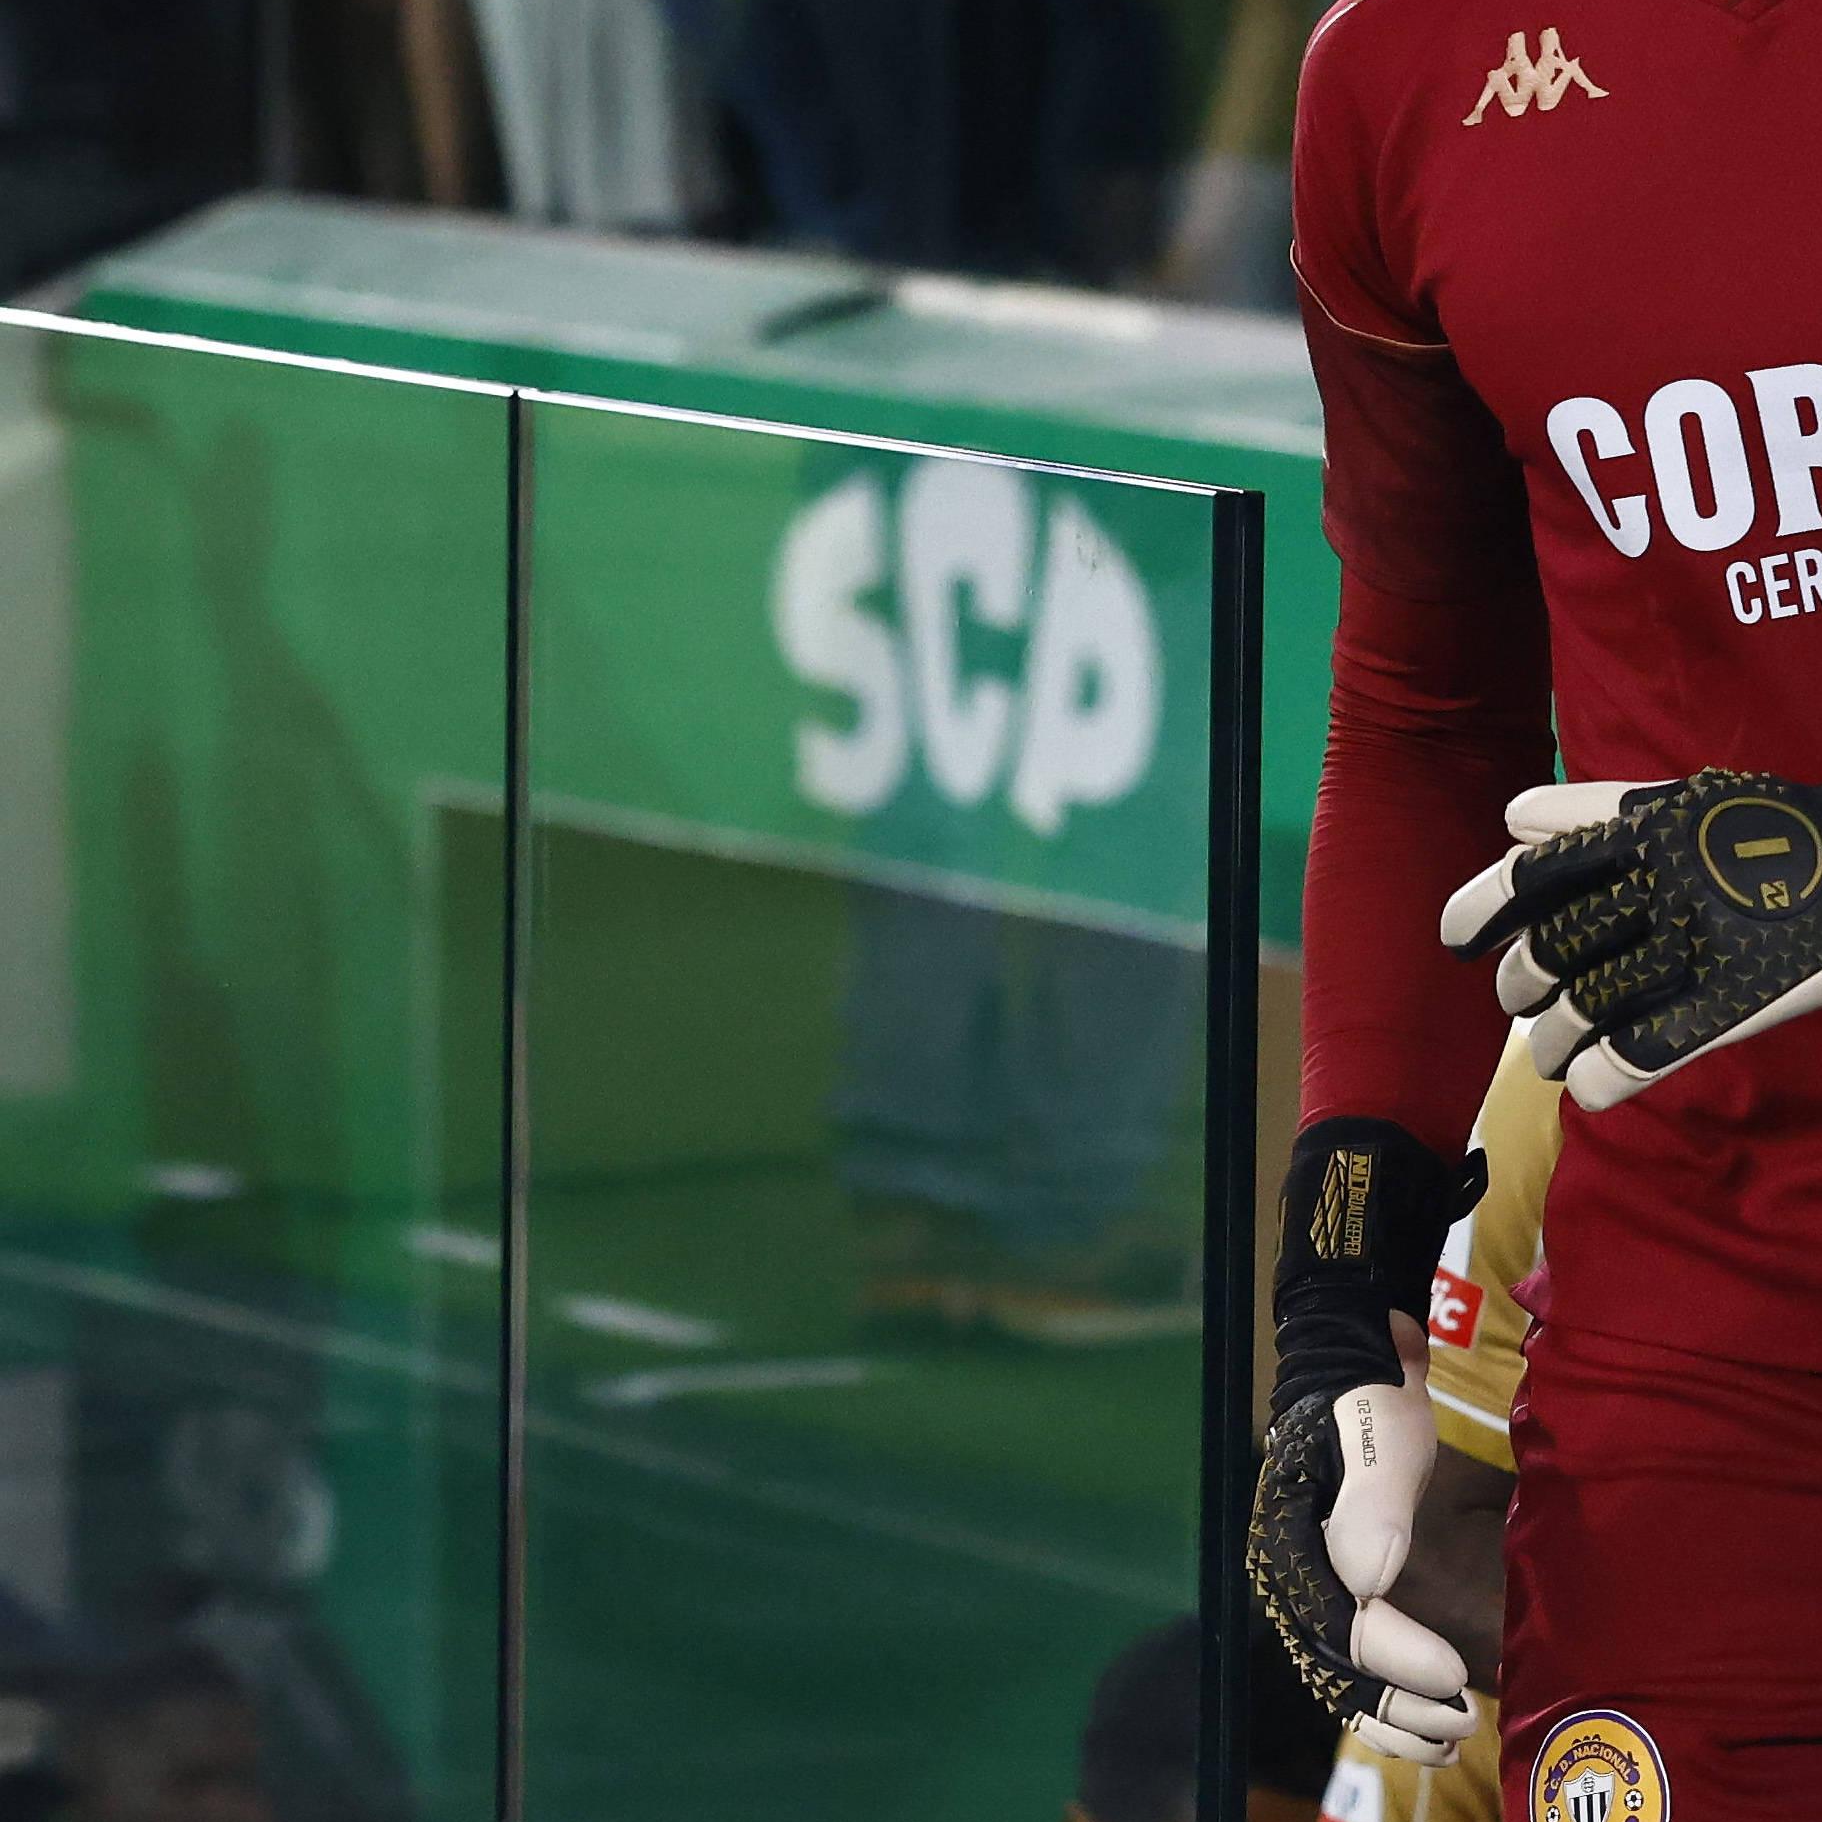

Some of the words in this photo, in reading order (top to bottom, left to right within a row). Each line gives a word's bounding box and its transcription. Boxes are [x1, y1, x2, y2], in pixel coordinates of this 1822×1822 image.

[770, 442, 1165, 837] SCP
[1356, 1398, 1371, 1415] 2.0
[1359, 1415, 1377, 1467] SCORPIUS
[1572, 1743, 1634, 1781] NACIONAL
